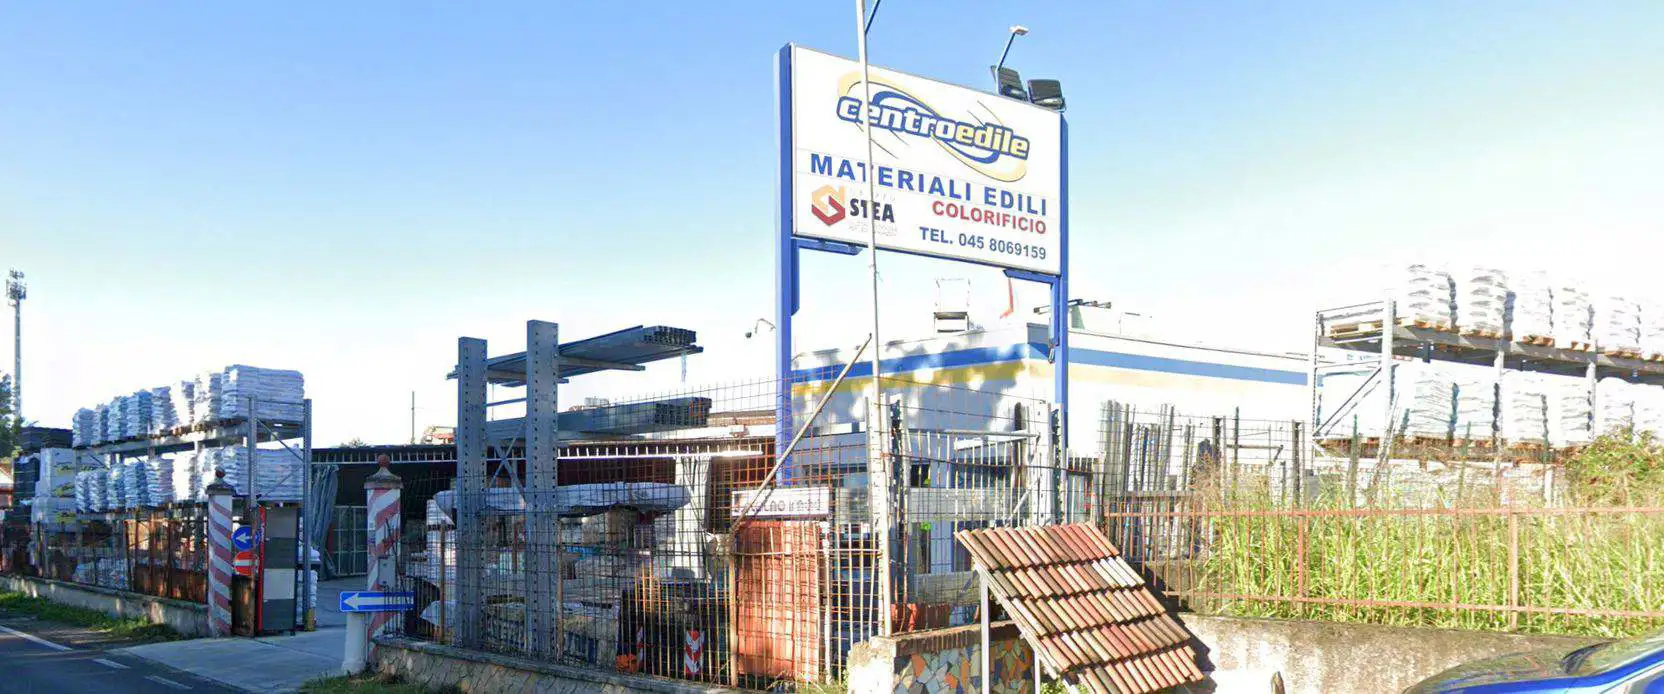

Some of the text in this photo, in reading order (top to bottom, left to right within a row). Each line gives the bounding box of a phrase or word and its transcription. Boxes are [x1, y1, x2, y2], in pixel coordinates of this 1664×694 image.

[837, 96, 1030, 160] centroedile
[850, 198, 895, 223] STEA
[932, 201, 1047, 235] COLORIFICIO
[984, 187, 1047, 216] EDILI
[919, 227, 953, 245] TEL.
[958, 233, 984, 249] 045
[989, 240, 1047, 260] 8069159
